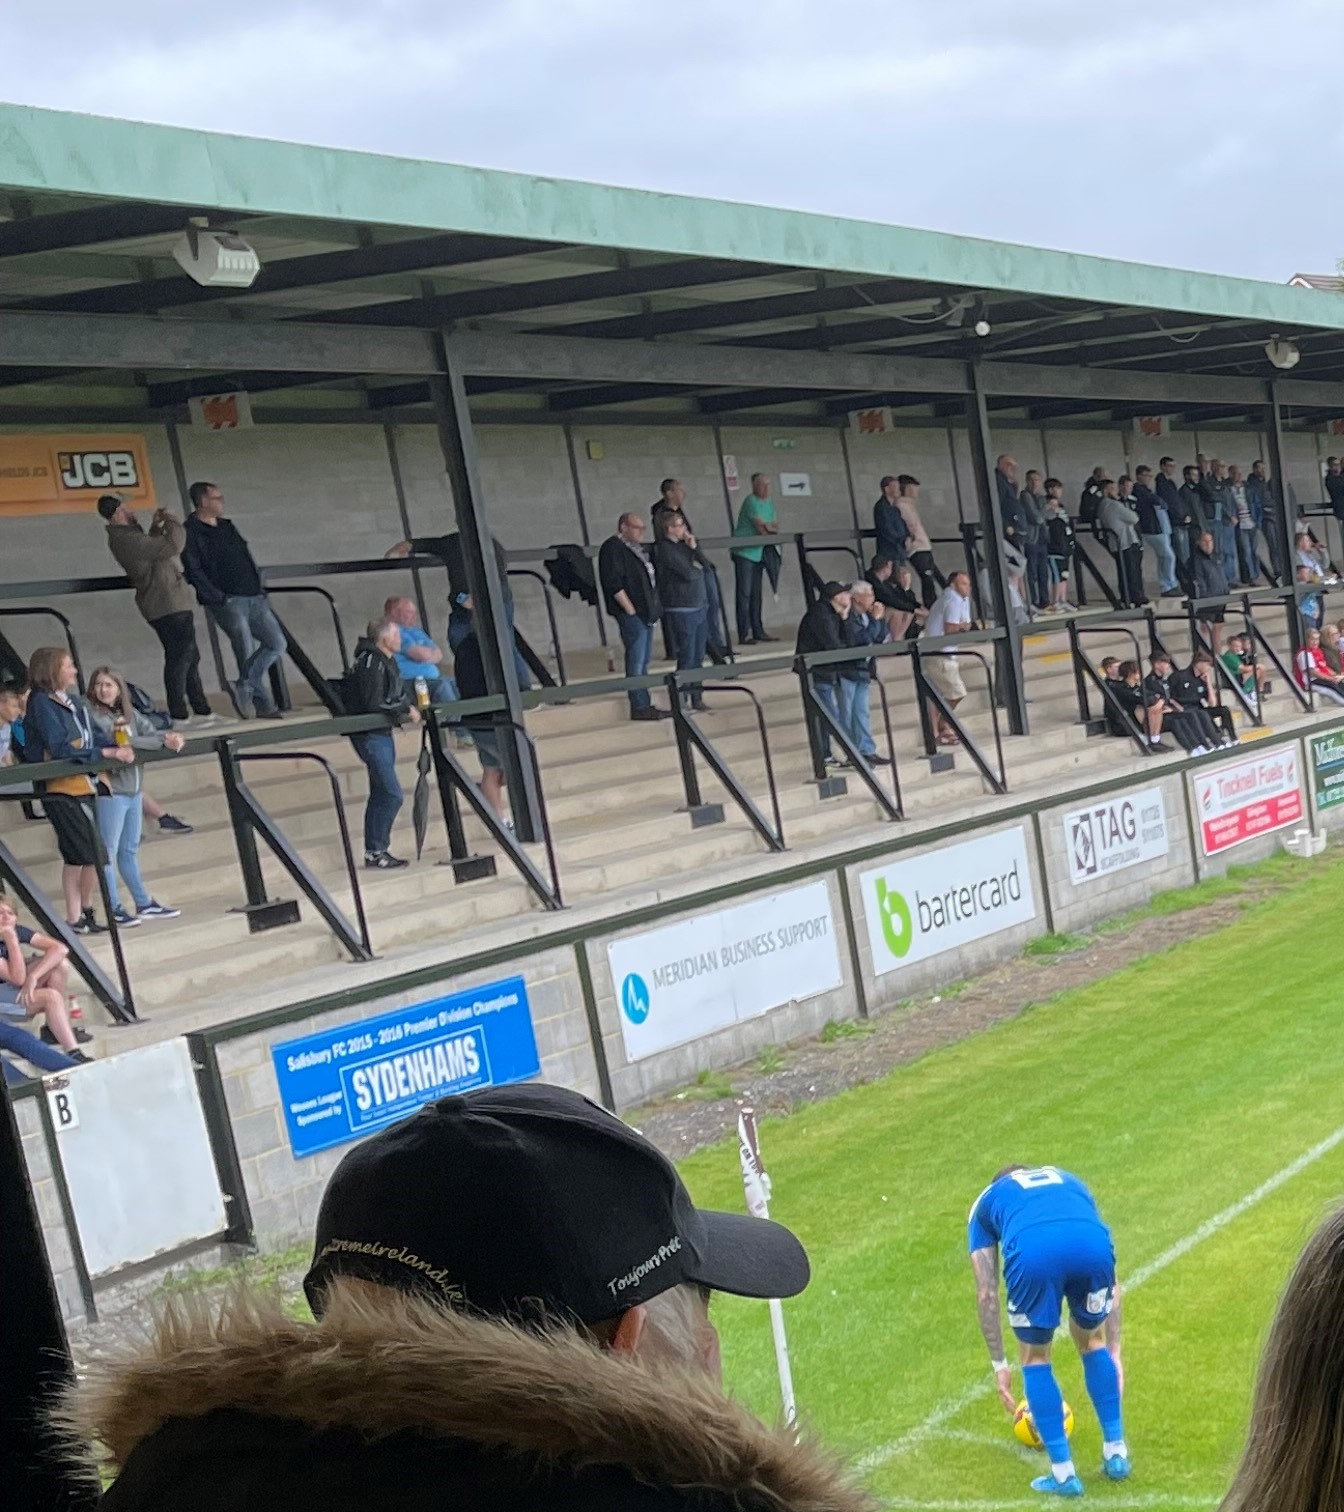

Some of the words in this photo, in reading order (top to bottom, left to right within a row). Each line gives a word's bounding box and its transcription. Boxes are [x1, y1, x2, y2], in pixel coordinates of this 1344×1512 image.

[62, 452, 137, 487] JCB
[1095, 801, 1136, 850] TAG
[916, 859, 1021, 933] bartercard
[652, 950, 718, 990] MERIDIAN
[720, 930, 776, 968] BUSINESS
[777, 914, 828, 950] SUPPORT
[287, 1046, 332, 1072] Salisbury
[332, 1042, 347, 1057] FC
[348, 1034, 374, 1055] 2015
[404, 1016, 438, 1038] Premier
[439, 1006, 474, 1027] Division
[473, 993, 519, 1016] Champions
[352, 1035, 481, 1111] SYDENHAMS
[55, 1094, 72, 1125] B
[607, 1254, 661, 1296] Toujours
